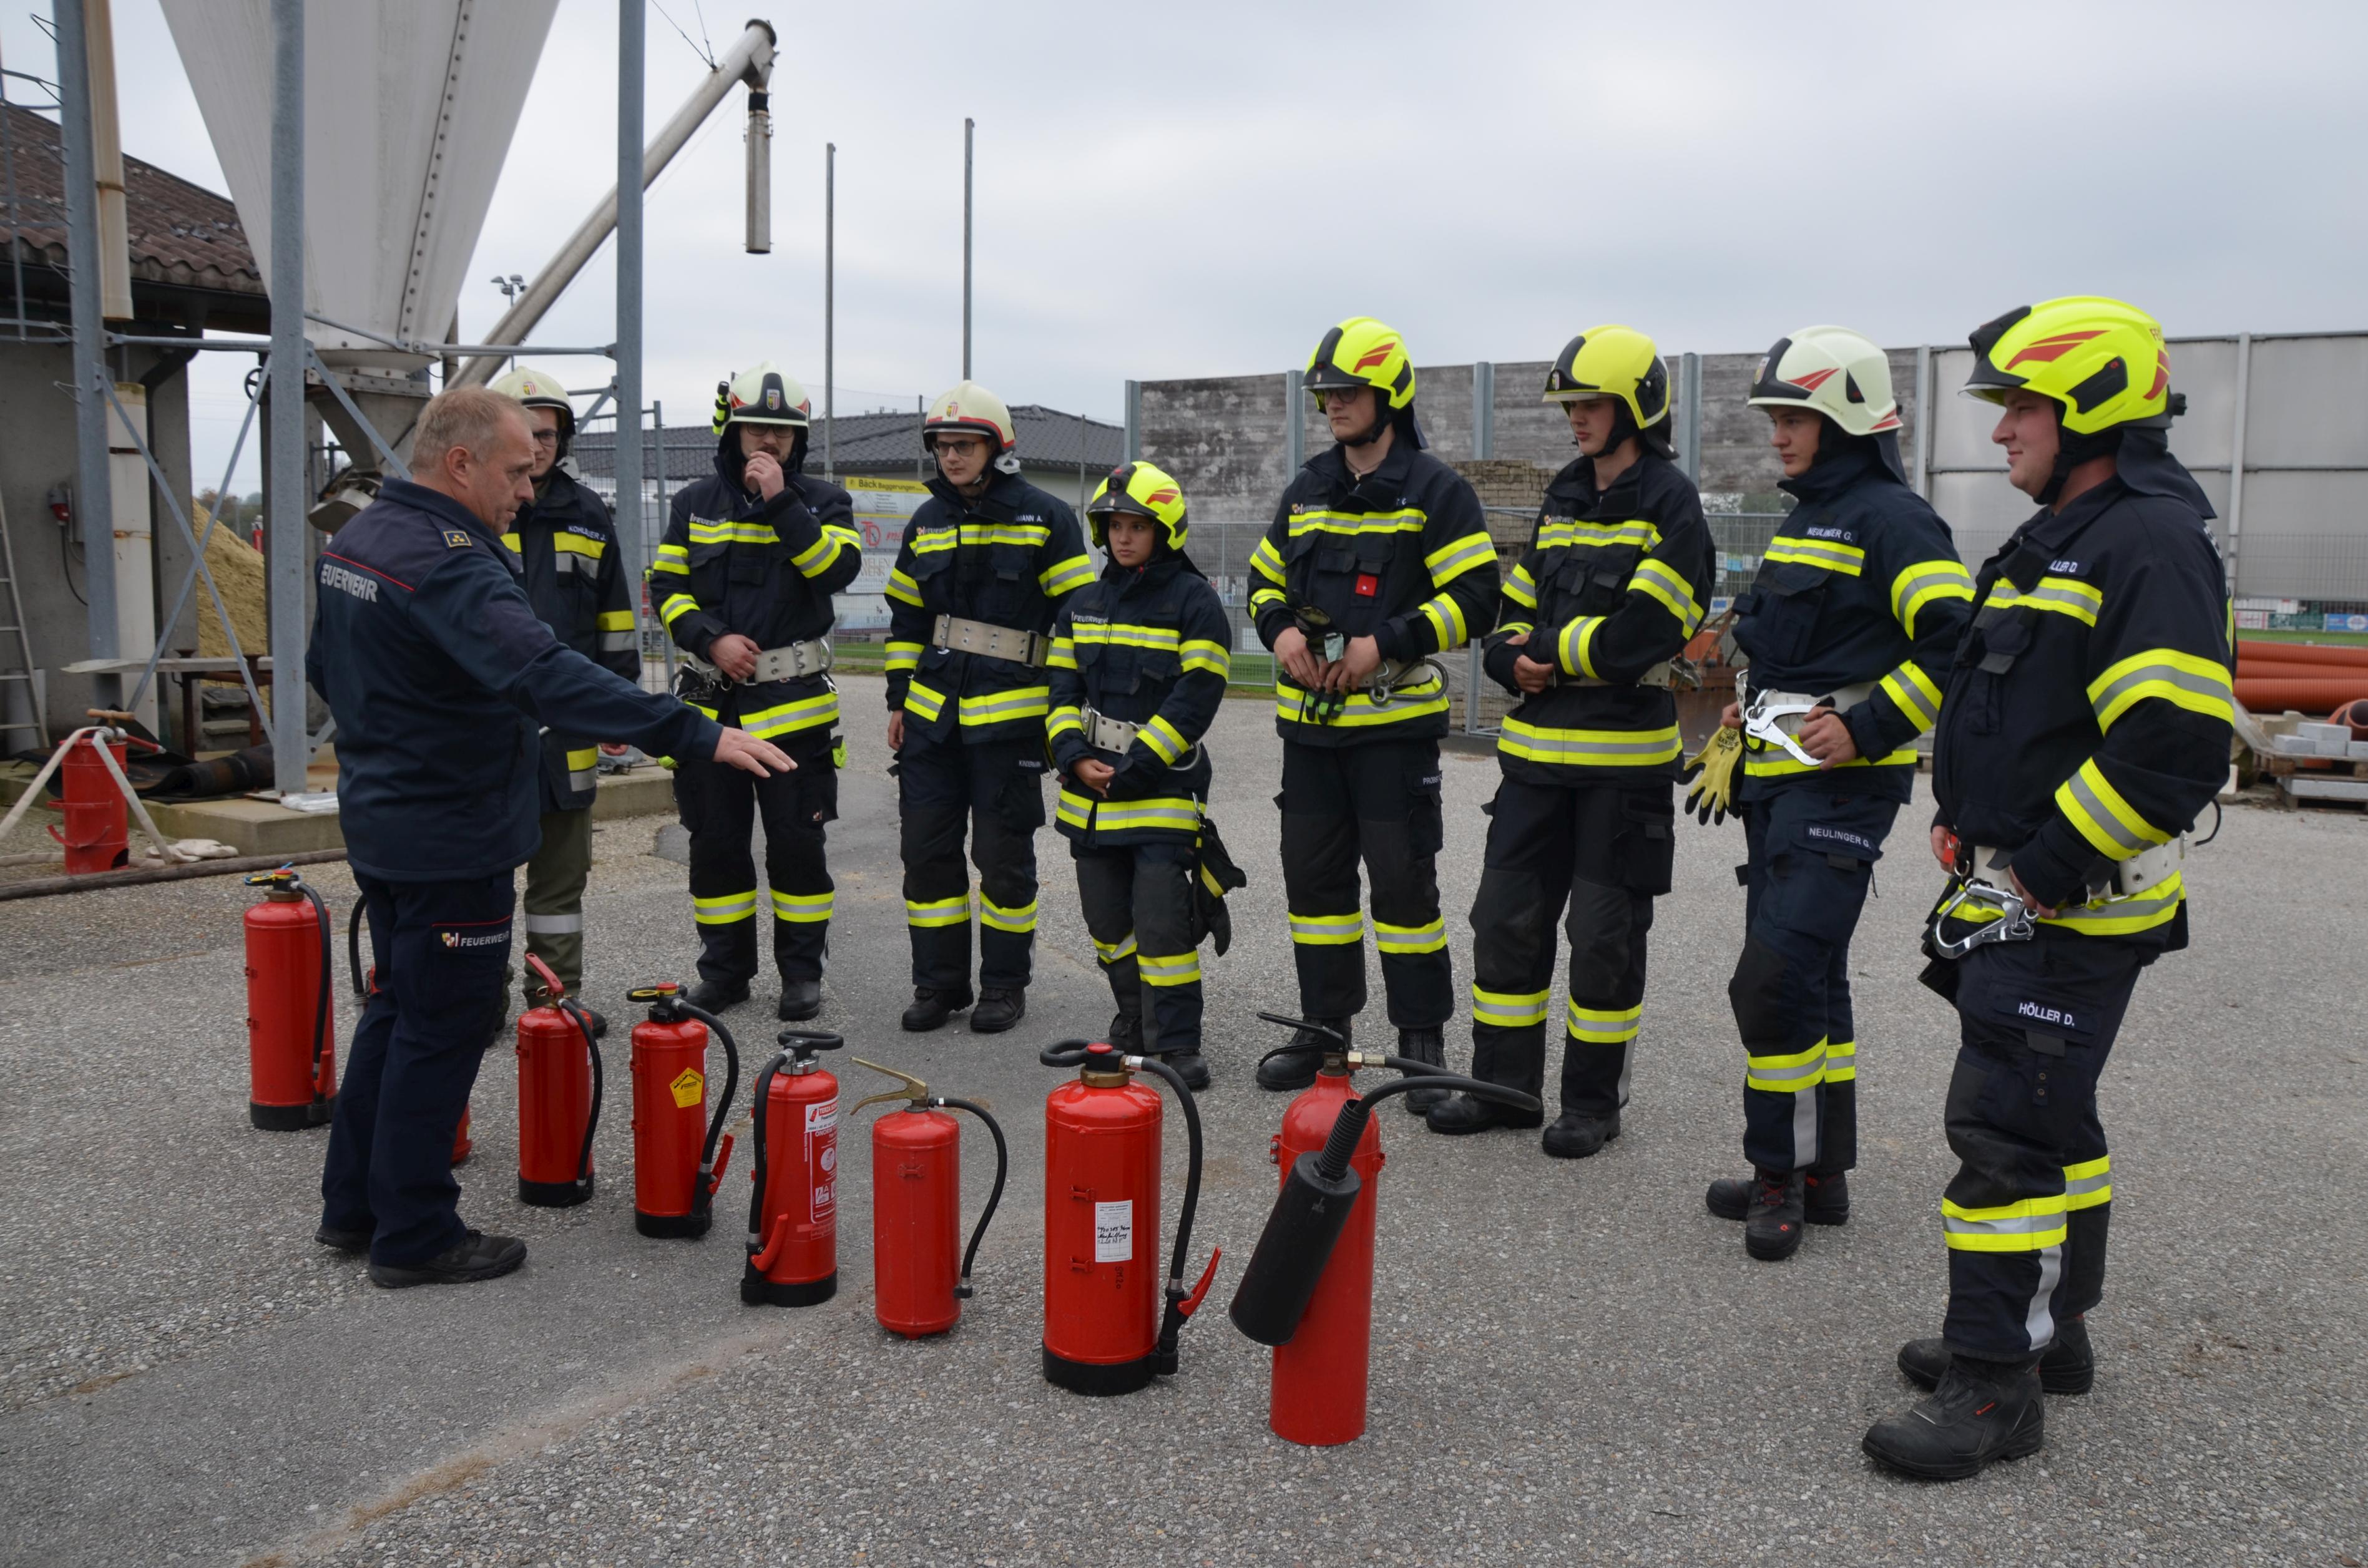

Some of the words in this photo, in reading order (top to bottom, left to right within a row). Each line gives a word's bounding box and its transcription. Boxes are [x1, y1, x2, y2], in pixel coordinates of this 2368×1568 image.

[859, 479, 878, 488] Bäck
[1844, 532, 1853, 542] G.
[1809, 827, 1861, 845] NEULINGER
[1862, 839, 1872, 849] G.
[2018, 1001, 2061, 1023] HÖLLER
[2063, 1013, 2075, 1026] D.
